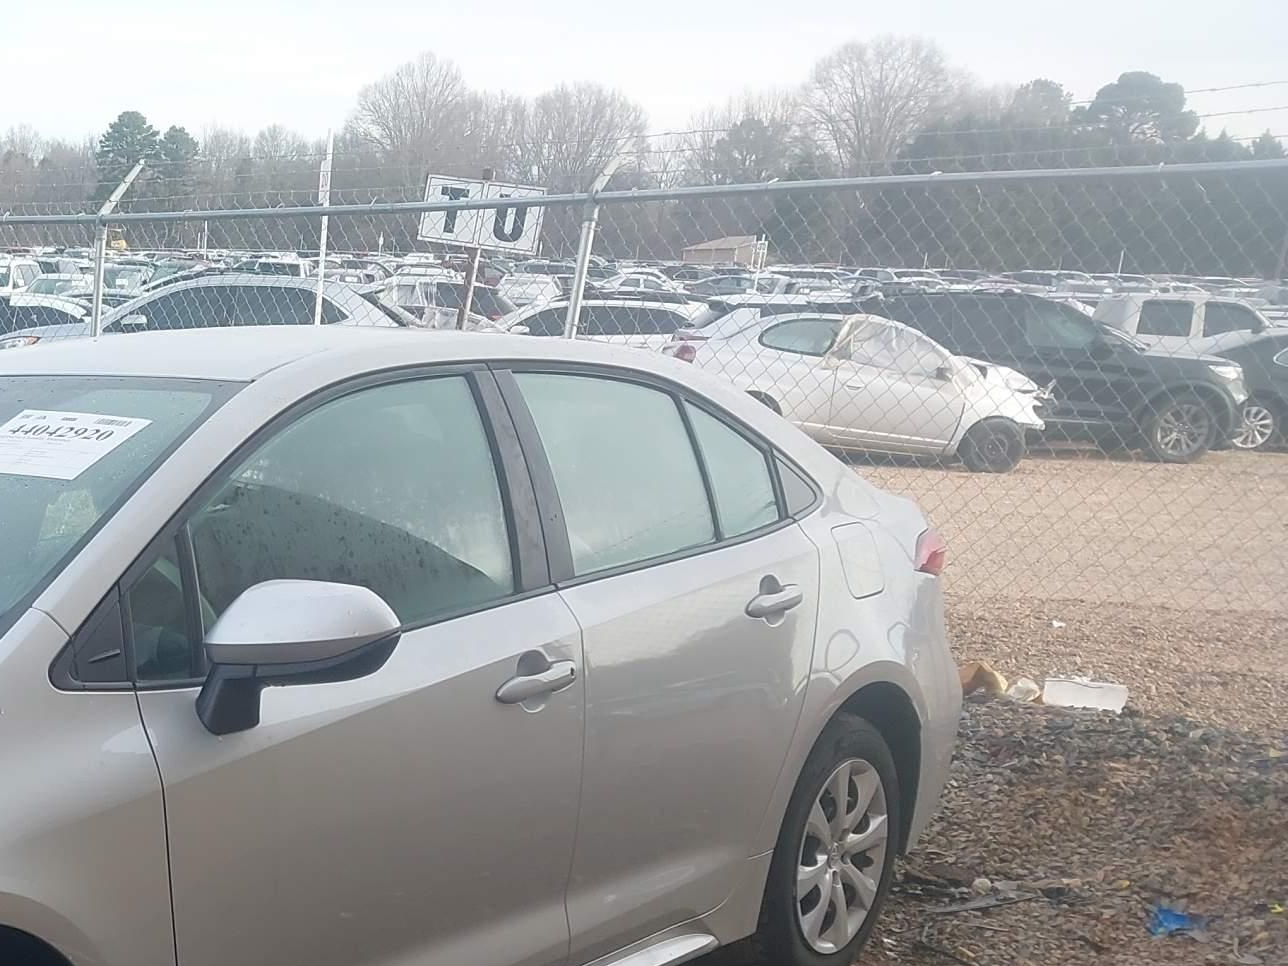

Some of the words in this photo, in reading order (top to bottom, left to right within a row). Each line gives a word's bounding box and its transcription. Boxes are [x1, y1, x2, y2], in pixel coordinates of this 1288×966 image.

[440, 186, 470, 233] T
[493, 192, 527, 242] U
[9, 423, 115, 442] 44042920
